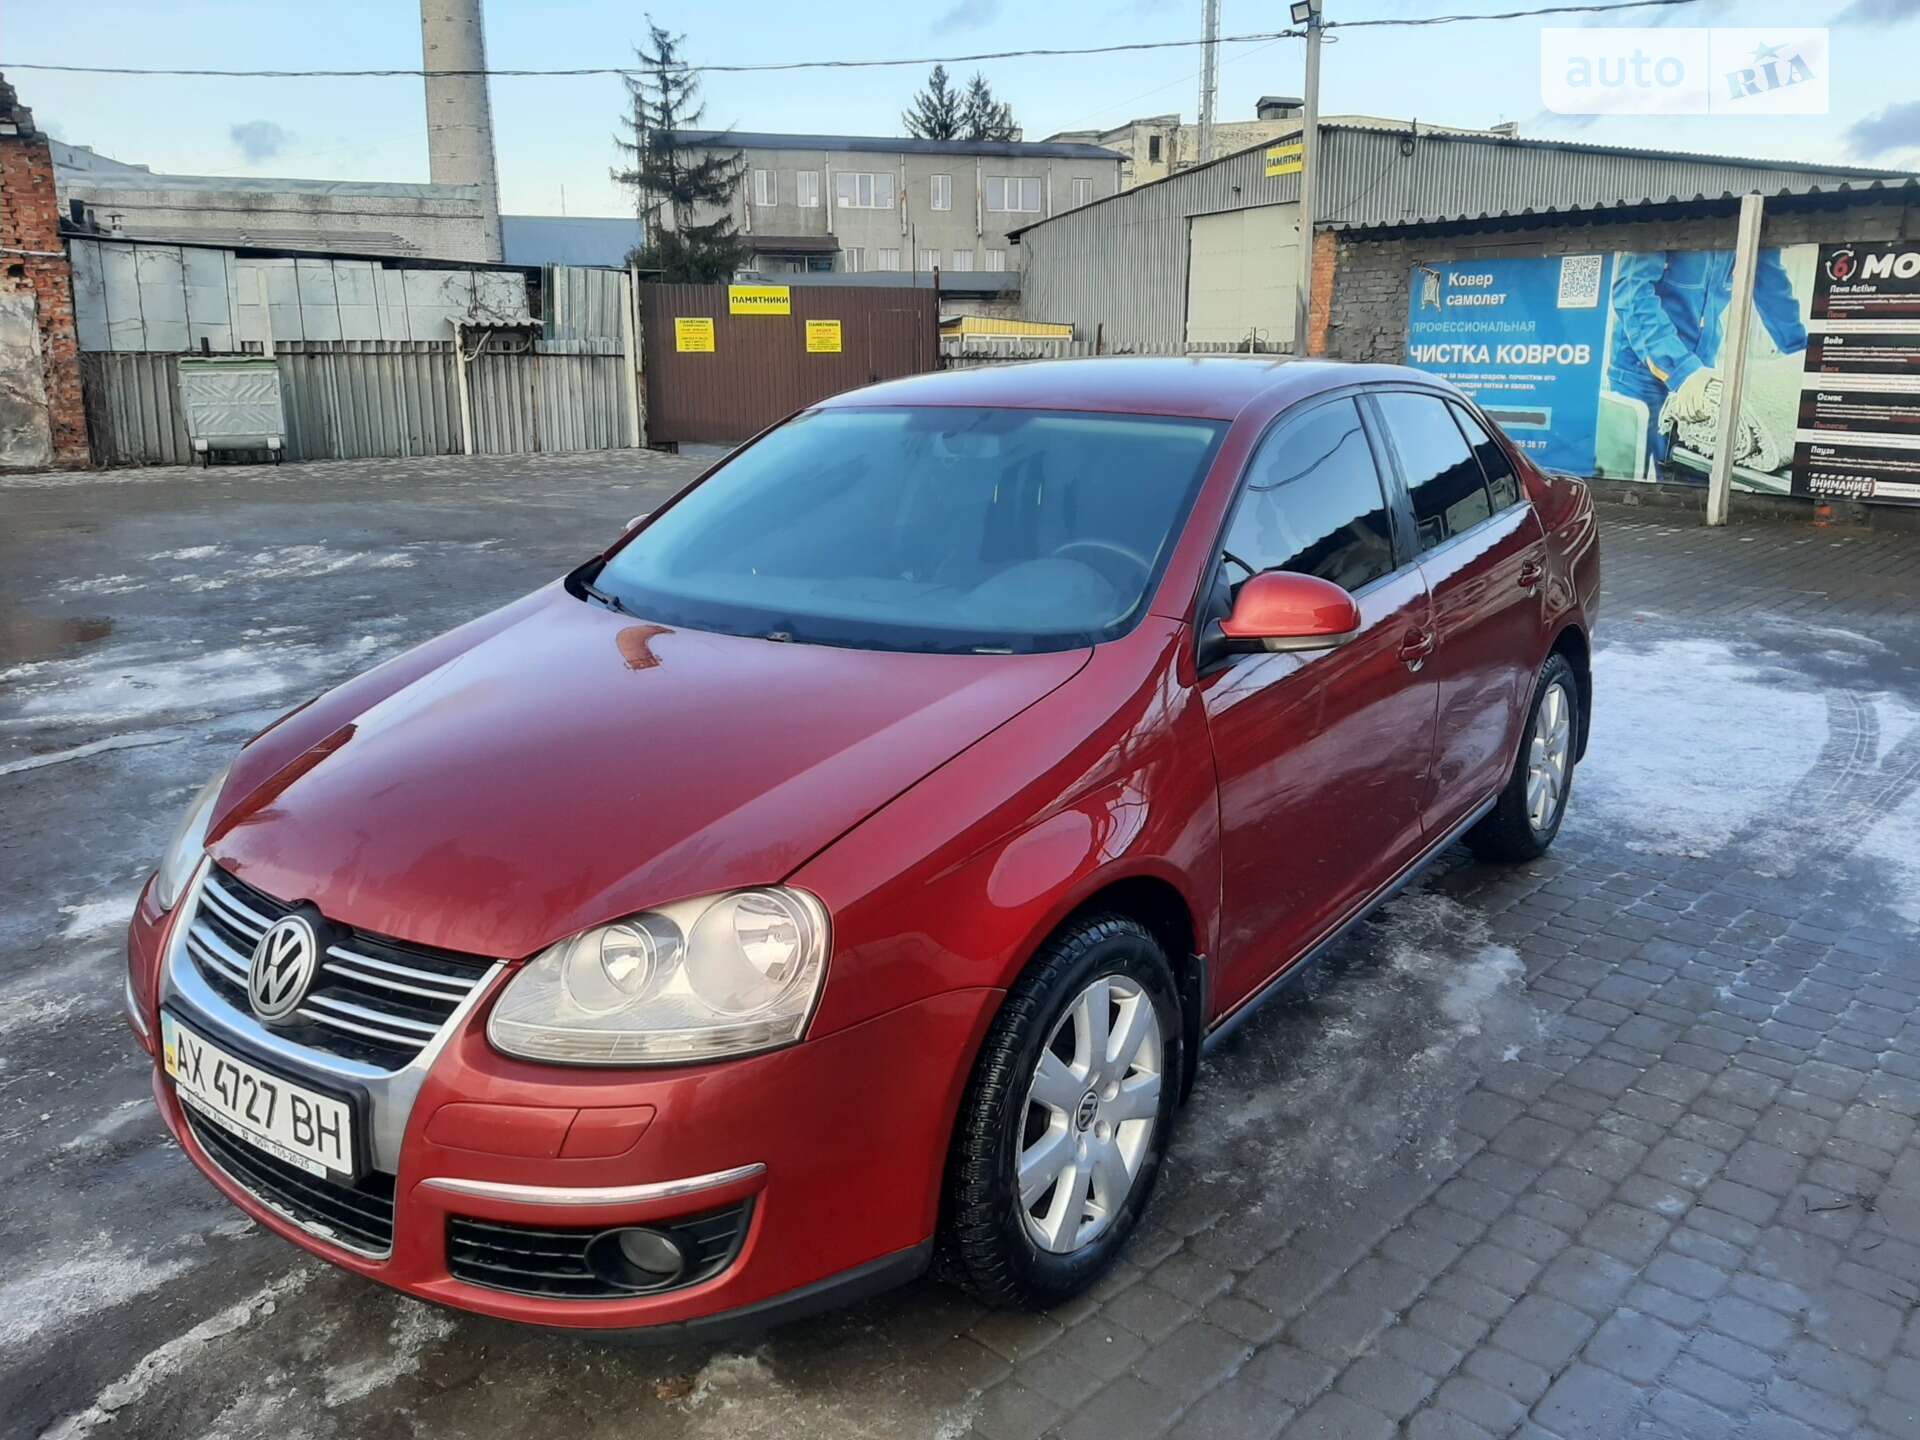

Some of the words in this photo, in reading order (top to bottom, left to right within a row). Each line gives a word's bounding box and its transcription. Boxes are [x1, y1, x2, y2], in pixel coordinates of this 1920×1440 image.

[1448, 272, 1493, 288] Ковер
[732, 295, 789, 304] ПАМЯТНИКИ
[1447, 292, 1507, 306] самолет
[1412, 320, 1537, 333] ПРОФЕССИОНАЛЬНАЯ
[1410, 344, 1490, 364] ЧИСТКА
[1496, 344, 1591, 365] КОВРОВ
[1810, 478, 1873, 492] ВНИМАНИЕ!
[177, 1032, 206, 1093] AX
[213, 1060, 278, 1130] 4727
[291, 1094, 342, 1160] BH
